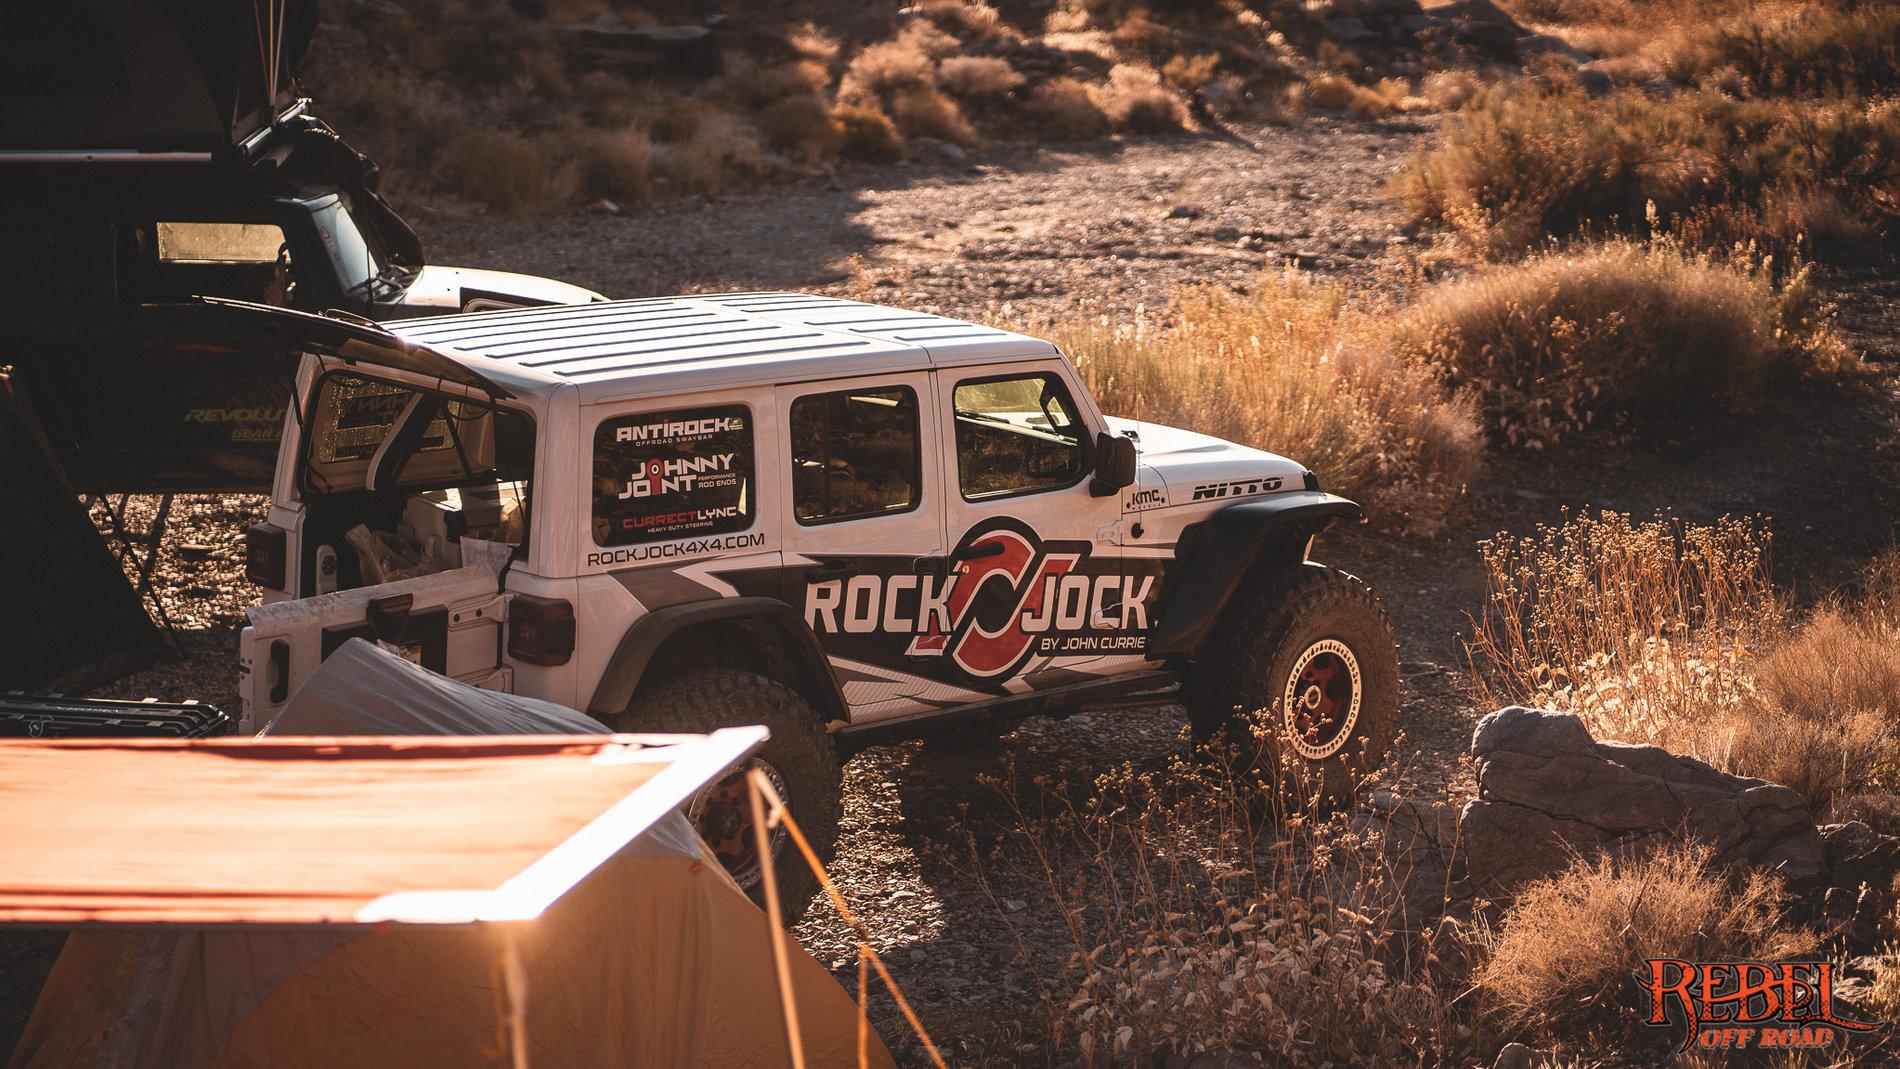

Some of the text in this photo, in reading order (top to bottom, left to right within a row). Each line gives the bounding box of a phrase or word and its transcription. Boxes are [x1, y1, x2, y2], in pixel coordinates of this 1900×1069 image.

[616, 417, 730, 442] ANTIROCK
[635, 434, 713, 447] OFFROAD SWAYBAR
[631, 453, 735, 480] JOHNNY
[698, 472, 736, 481] PERFORMANCE
[618, 474, 697, 500] JOINT
[698, 478, 737, 489] ROD ENDS
[1192, 476, 1283, 500] NITTO
[1132, 489, 1160, 505] KMC
[622, 506, 737, 529] CURRECTLYNC
[647, 521, 714, 534] HEAVY DUTY STEERING
[587, 532, 765, 567] ROCKJOCK4X4.COM
[805, 574, 1155, 633] ROCK JOCK
[1041, 636, 1146, 650] BY JOHN CURRIE
